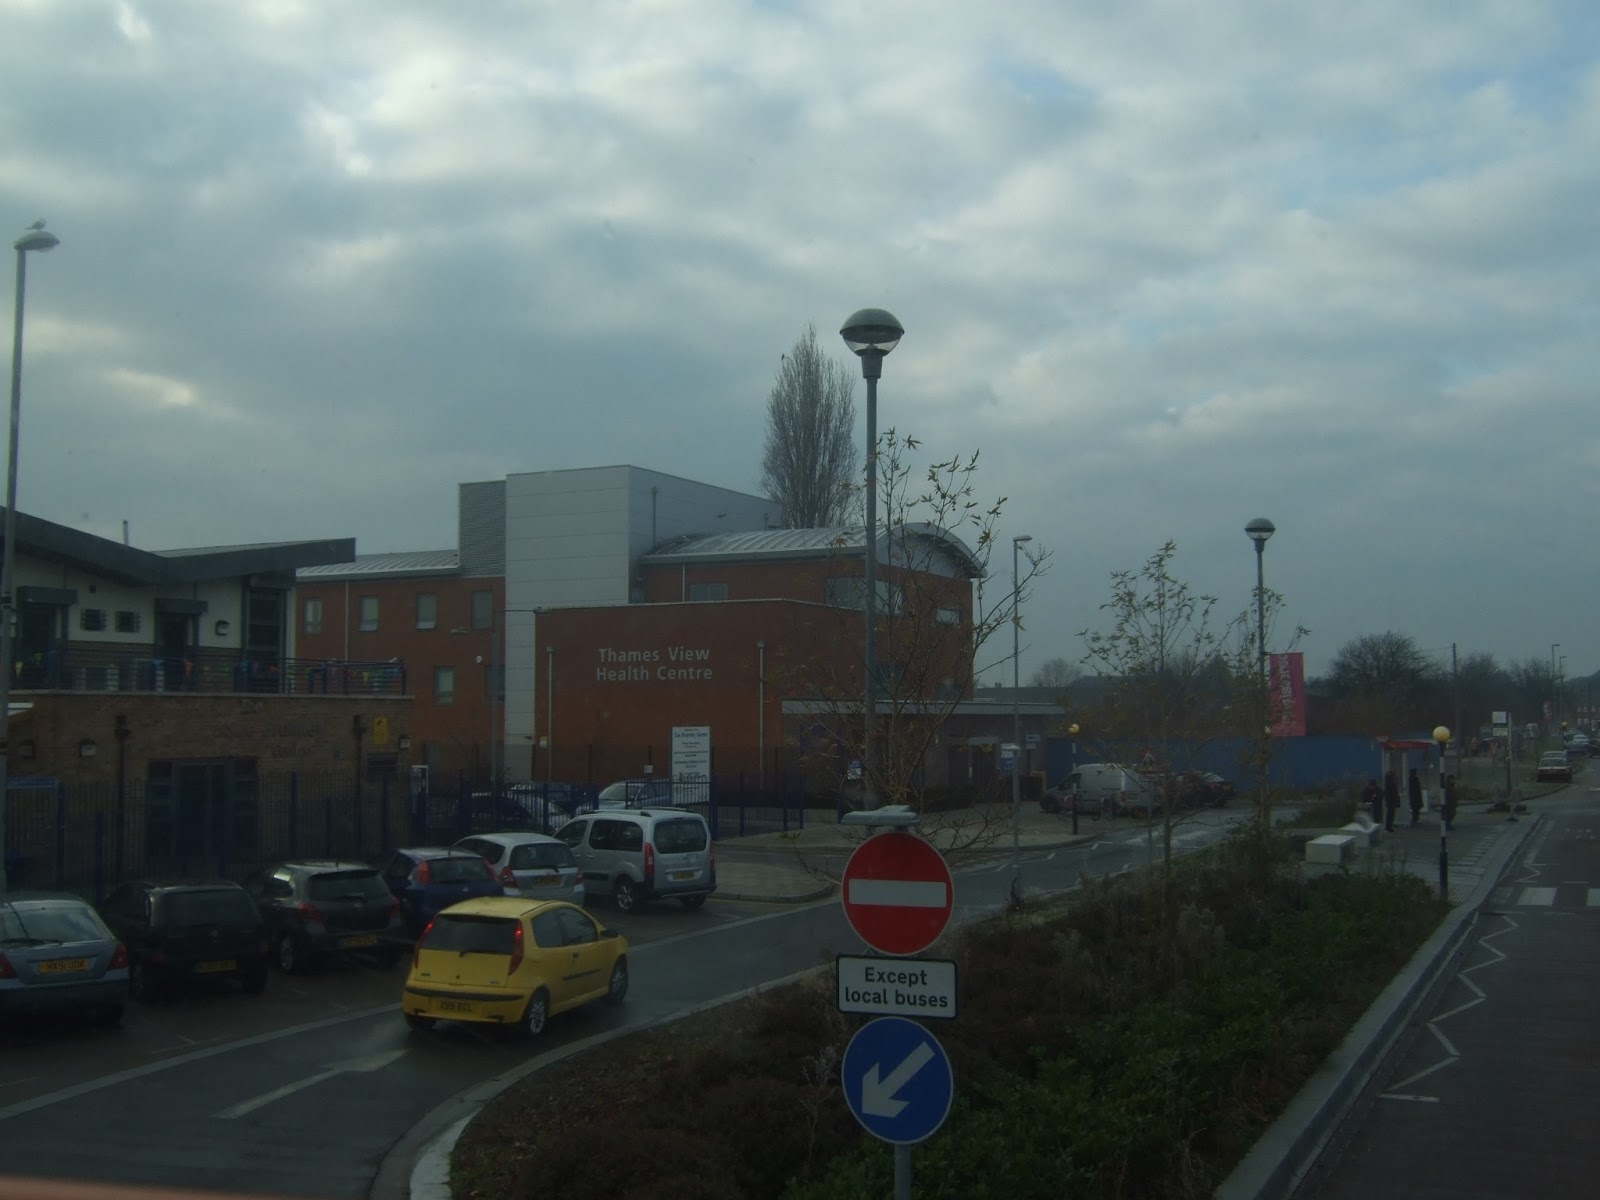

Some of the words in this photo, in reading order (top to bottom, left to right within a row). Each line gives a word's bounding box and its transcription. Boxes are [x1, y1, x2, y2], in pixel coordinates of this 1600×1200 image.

[598, 647, 660, 662] Thames
[668, 646, 710, 661] View
[596, 666, 649, 681] Health
[657, 666, 713, 681] Centre
[865, 966, 927, 987] Except
[845, 986, 888, 1004] local
[895, 989, 948, 1008] buses
